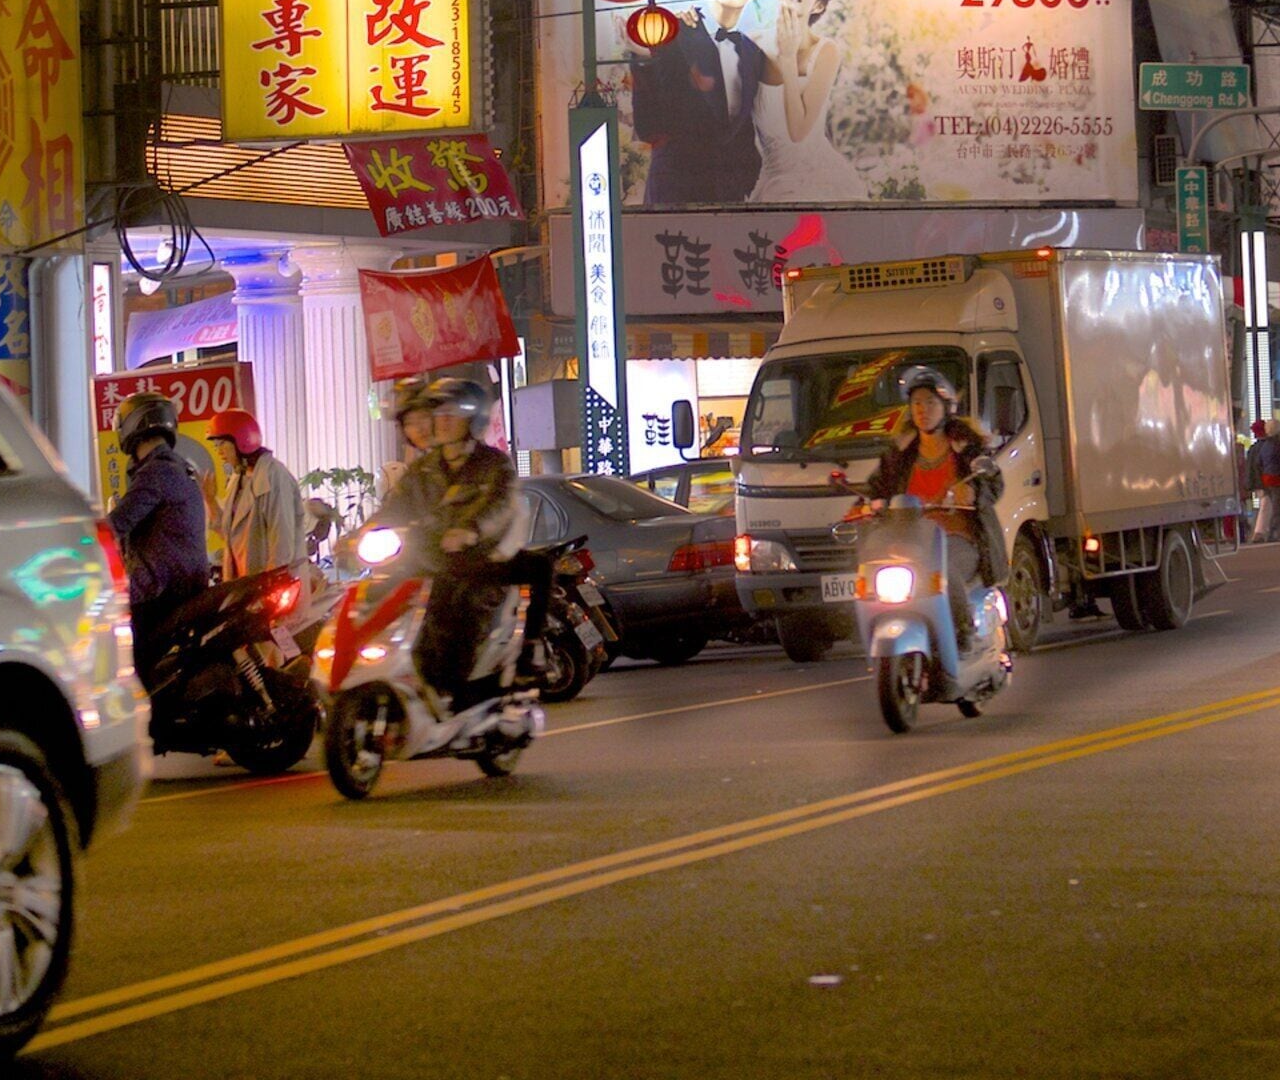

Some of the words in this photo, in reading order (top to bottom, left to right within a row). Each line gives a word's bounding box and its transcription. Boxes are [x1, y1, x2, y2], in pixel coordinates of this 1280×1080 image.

[1152, 69, 1237, 88] 成功路
[596, 416, 616, 476] 中華路
